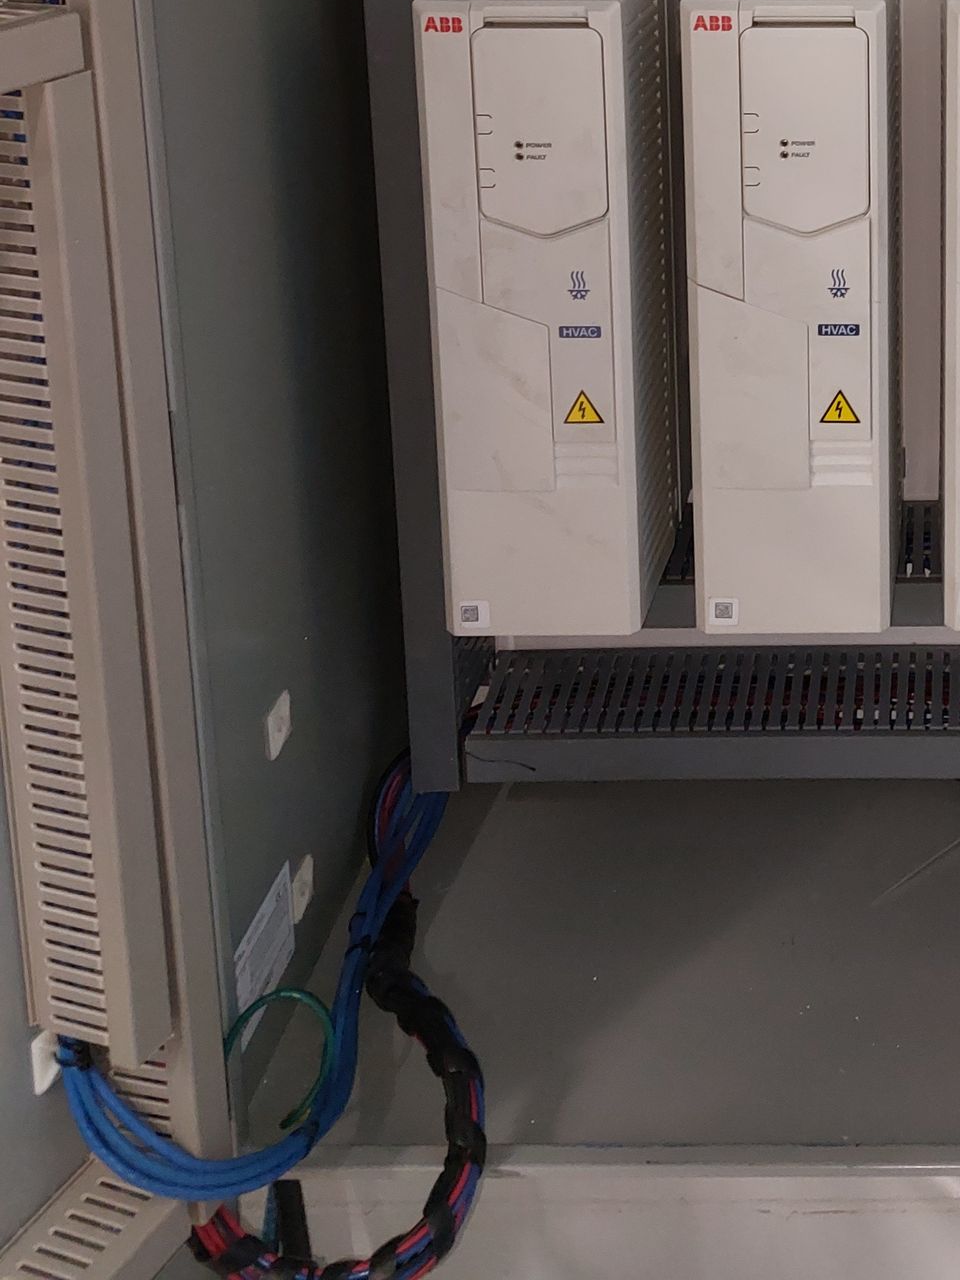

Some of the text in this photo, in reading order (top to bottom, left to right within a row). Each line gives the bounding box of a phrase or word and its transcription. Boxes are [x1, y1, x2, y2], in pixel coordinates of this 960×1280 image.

[424, 16, 463, 33] ABB
[693, 15, 733, 32] ABB
[562, 327, 598, 338] HVAC
[821, 325, 857, 336] HVAC
